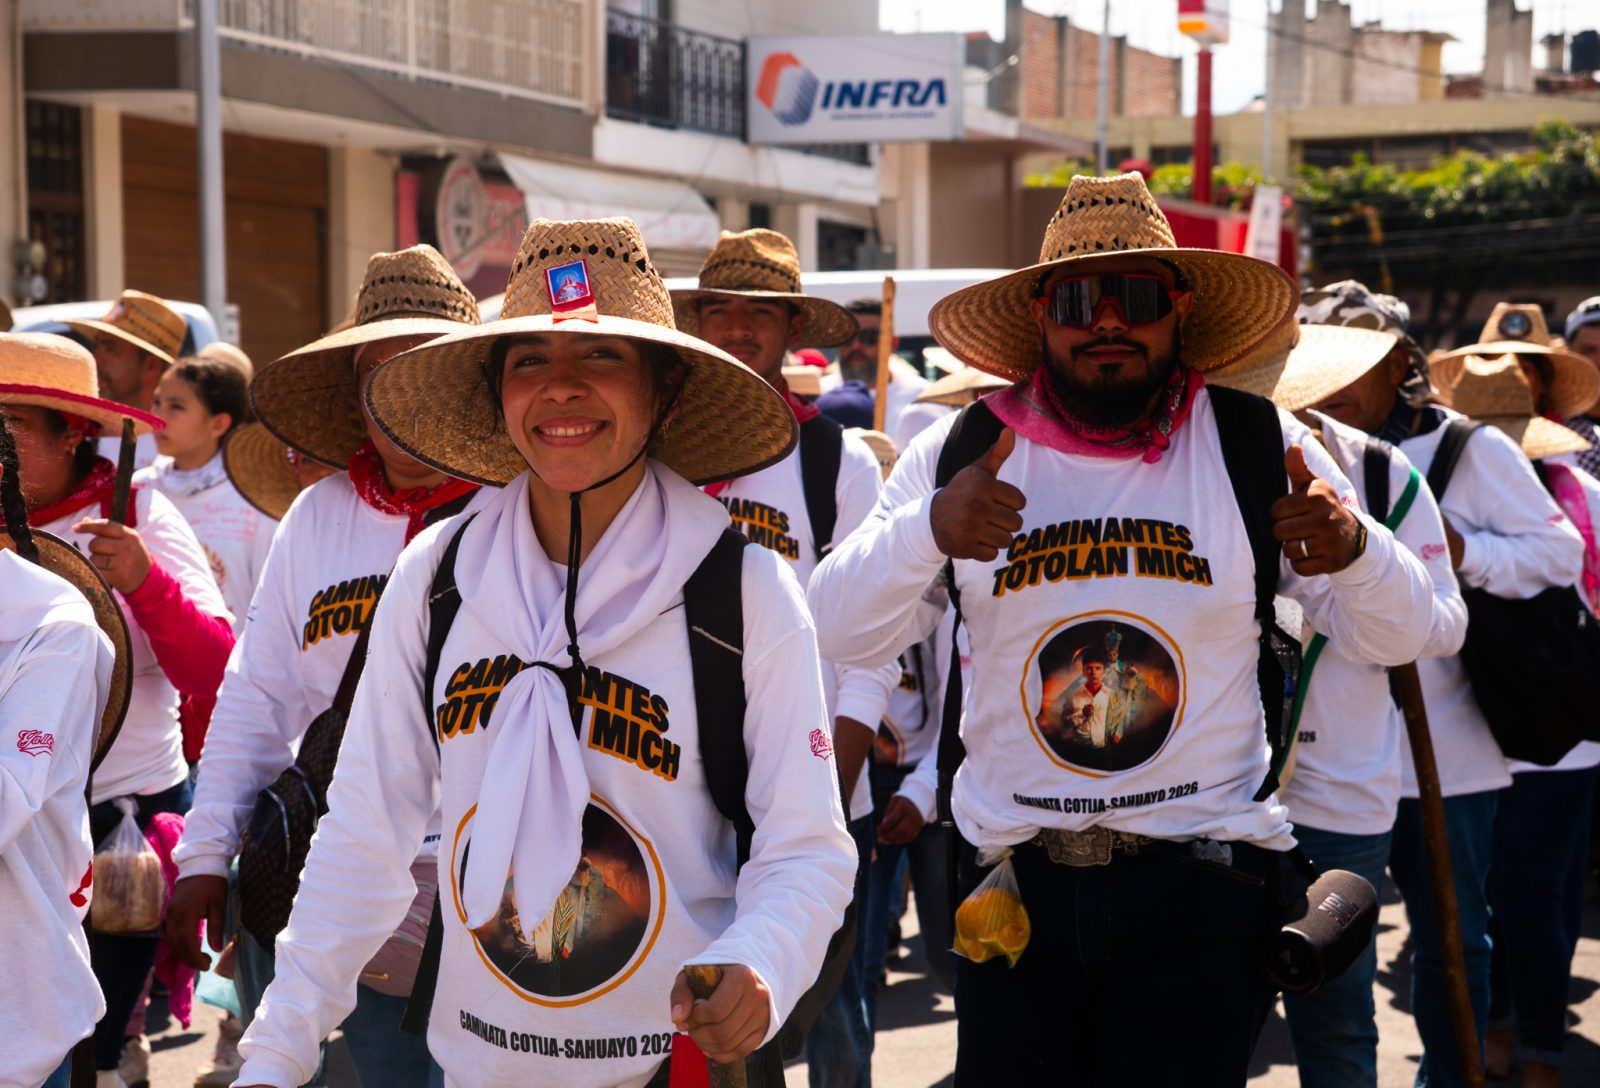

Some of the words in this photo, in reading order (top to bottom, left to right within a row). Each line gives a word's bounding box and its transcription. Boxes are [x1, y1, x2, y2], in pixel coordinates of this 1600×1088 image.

[820, 78, 947, 109] INFRA
[1007, 517, 1194, 562] CAMINANTES
[1133, 546, 1213, 587] MICH
[588, 708, 681, 782] MICH
[1013, 793, 1063, 812] CAMINATA
[1063, 789, 1166, 814] COTIJA-SAHUAYO
[1168, 781, 1199, 801] 2026
[459, 1009, 508, 1050] CAMINATA
[510, 1031, 637, 1060] COTIJA-SAHUAYO
[640, 1031, 682, 1056] 202
